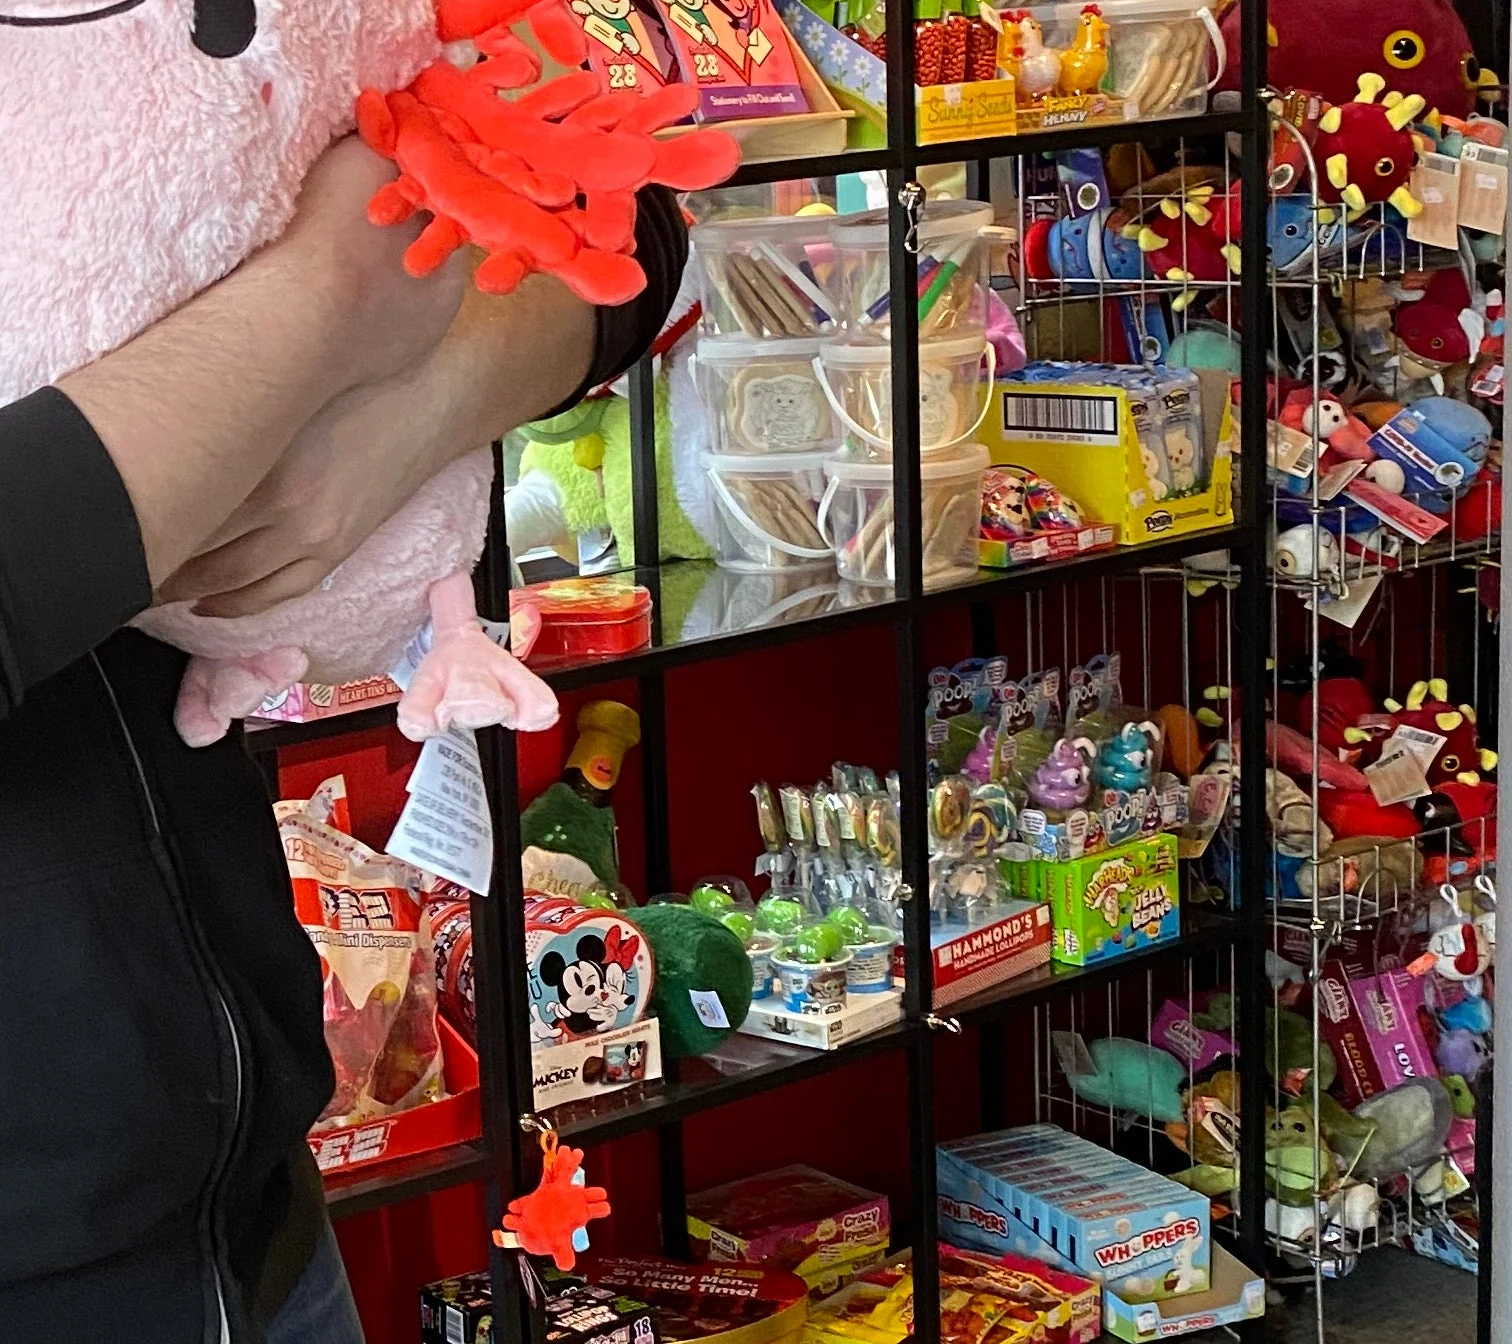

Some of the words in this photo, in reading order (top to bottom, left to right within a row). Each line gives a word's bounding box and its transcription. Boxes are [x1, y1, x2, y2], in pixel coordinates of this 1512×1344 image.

[608, 63, 638, 89] 28
[693, 53, 720, 77] 28
[1047, 96, 1088, 113] FANCY
[1043, 110, 1088, 127] HENNY
[340, 688, 367, 704] HEART
[367, 684, 385, 698] TINS
[285, 837, 305, 862] 12
[1083, 864, 1134, 908] WARHEADS
[1135, 884, 1170, 911] JELLY
[319, 885, 395, 931] PEZ
[1132, 900, 1172, 932] BEANS
[951, 913, 1034, 959] HAMMOND'S
[953, 941, 995, 970] HANDMADE
[995, 930, 1035, 954] LOLLIPOPS
[533, 1066, 579, 1089] MICKEY
[843, 1208, 879, 1229] Crazy
[612, 1267, 638, 1277] So
[641, 1269, 696, 1284] Many
[699, 1275, 759, 1288] Men...
[713, 1267, 737, 1277] 12
[598, 1275, 629, 1286] So
[633, 1278, 692, 1292] Little
[697, 1283, 759, 1299] Time!
[570, 1312, 619, 1333] RINGS
[635, 1317, 651, 1337] 18
